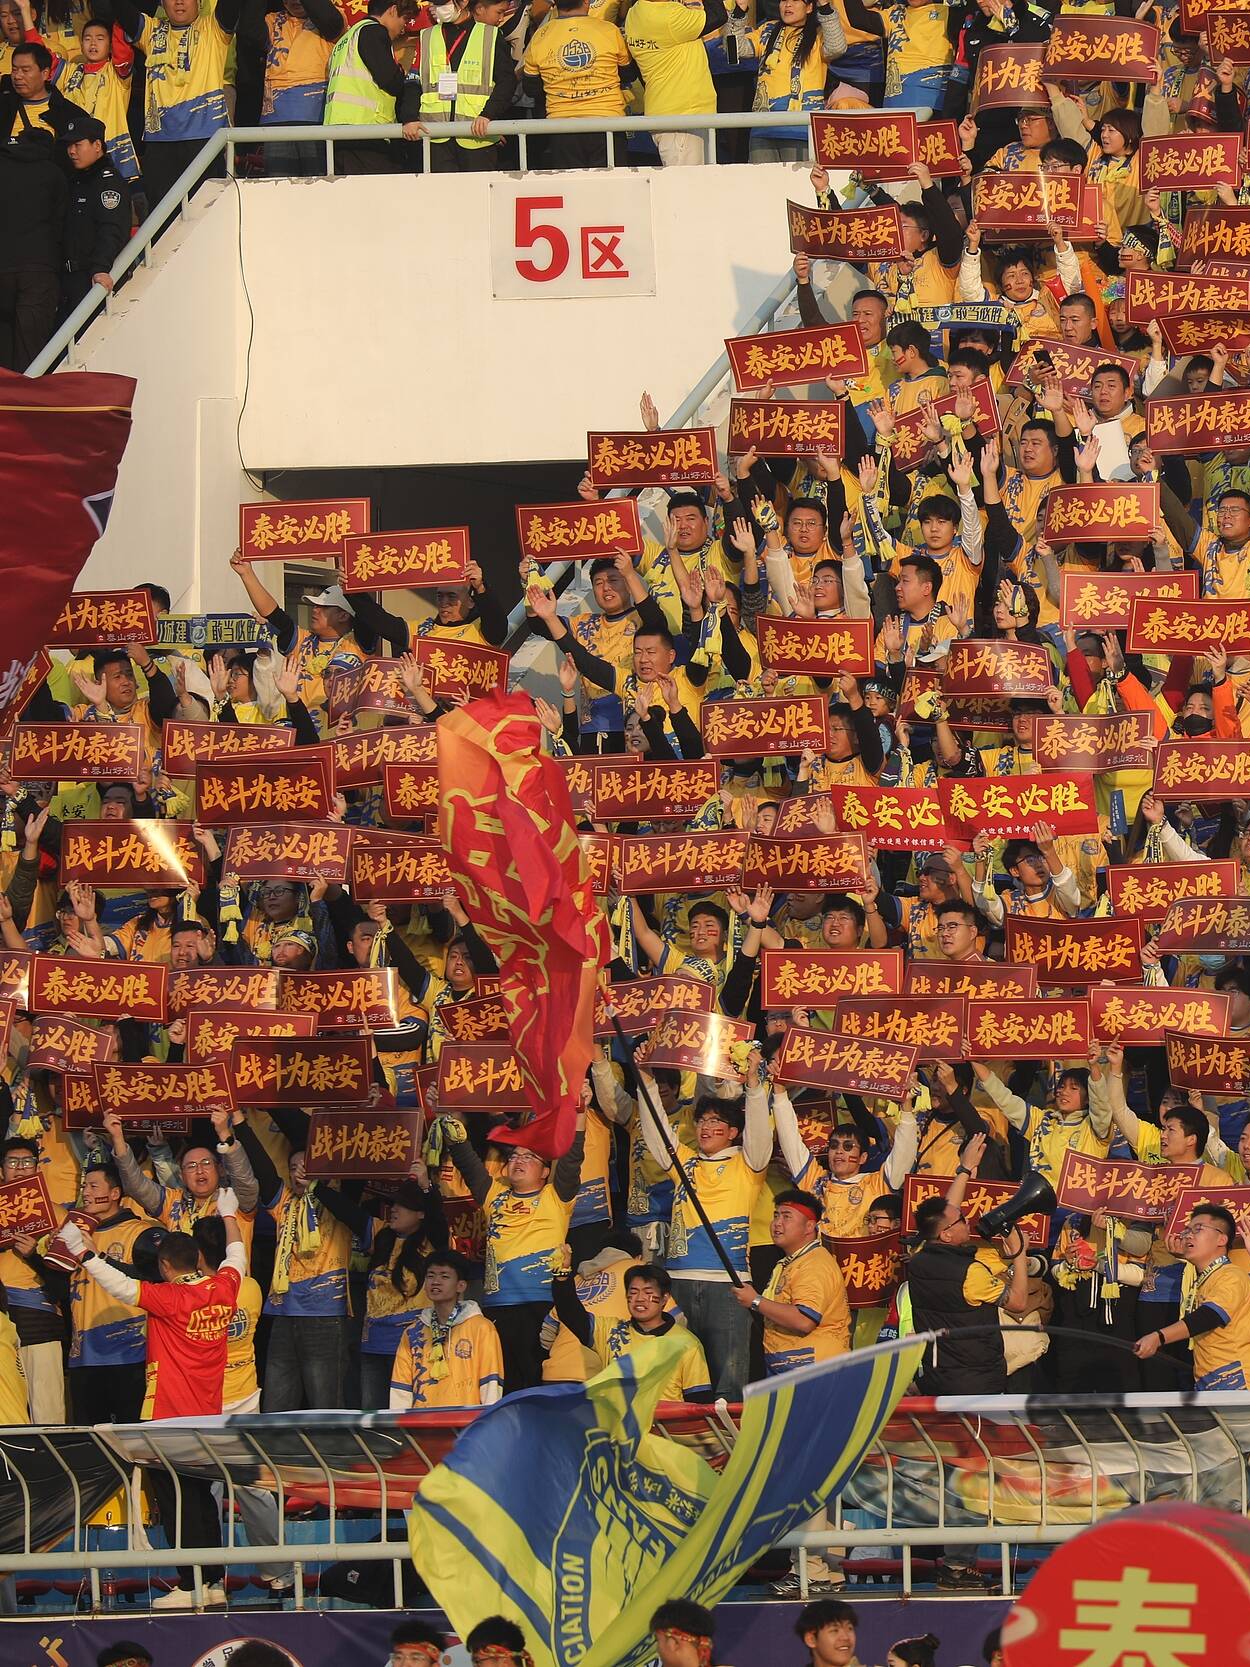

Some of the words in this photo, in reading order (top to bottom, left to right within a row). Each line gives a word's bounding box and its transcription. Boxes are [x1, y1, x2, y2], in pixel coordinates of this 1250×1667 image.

[821, 125, 910, 160] 泰安必胜
[1145, 144, 1230, 182] 泰安必胜
[514, 196, 629, 283] 5区
[792, 215, 898, 248] 战斗为泰安
[1131, 280, 1250, 312] 战斗为泰安
[744, 335, 857, 376] 泰安必胜
[732, 406, 839, 440] 战斗为泰安
[594, 435, 710, 473] 泰安必胜
[1049, 495, 1148, 530] 泰安必胜
[353, 540, 460, 580] 泰安必胜
[763, 629, 863, 663] 泰安必胜
[704, 702, 823, 743] 泰安必胜
[1039, 717, 1141, 758] 泰安必胜
[15, 730, 139, 764] 战斗为泰安
[201, 775, 321, 811] 战斗为泰安
[596, 768, 714, 802] 战斗为泰安
[950, 782, 1088, 820] 泰安必胜
[842, 791, 942, 829] 泰安必
[231, 831, 344, 866] 泰安必胜
[624, 837, 744, 872] 战斗为泰安
[745, 836, 862, 875] 战斗为泰安
[1013, 932, 1135, 970] 战斗为泰安
[42, 971, 156, 1005] 泰安必胜
[773, 964, 893, 996] 泰安必胜
[975, 1008, 1084, 1048] 泰安必胜
[1100, 997, 1218, 1034] 泰安必胜
[236, 1053, 362, 1090] 战斗为泰安
[786, 1034, 910, 1081] 战斗为泰安
[101, 1068, 230, 1103] 泰安必胜
[312, 1126, 411, 1160] 战斗为泰安
